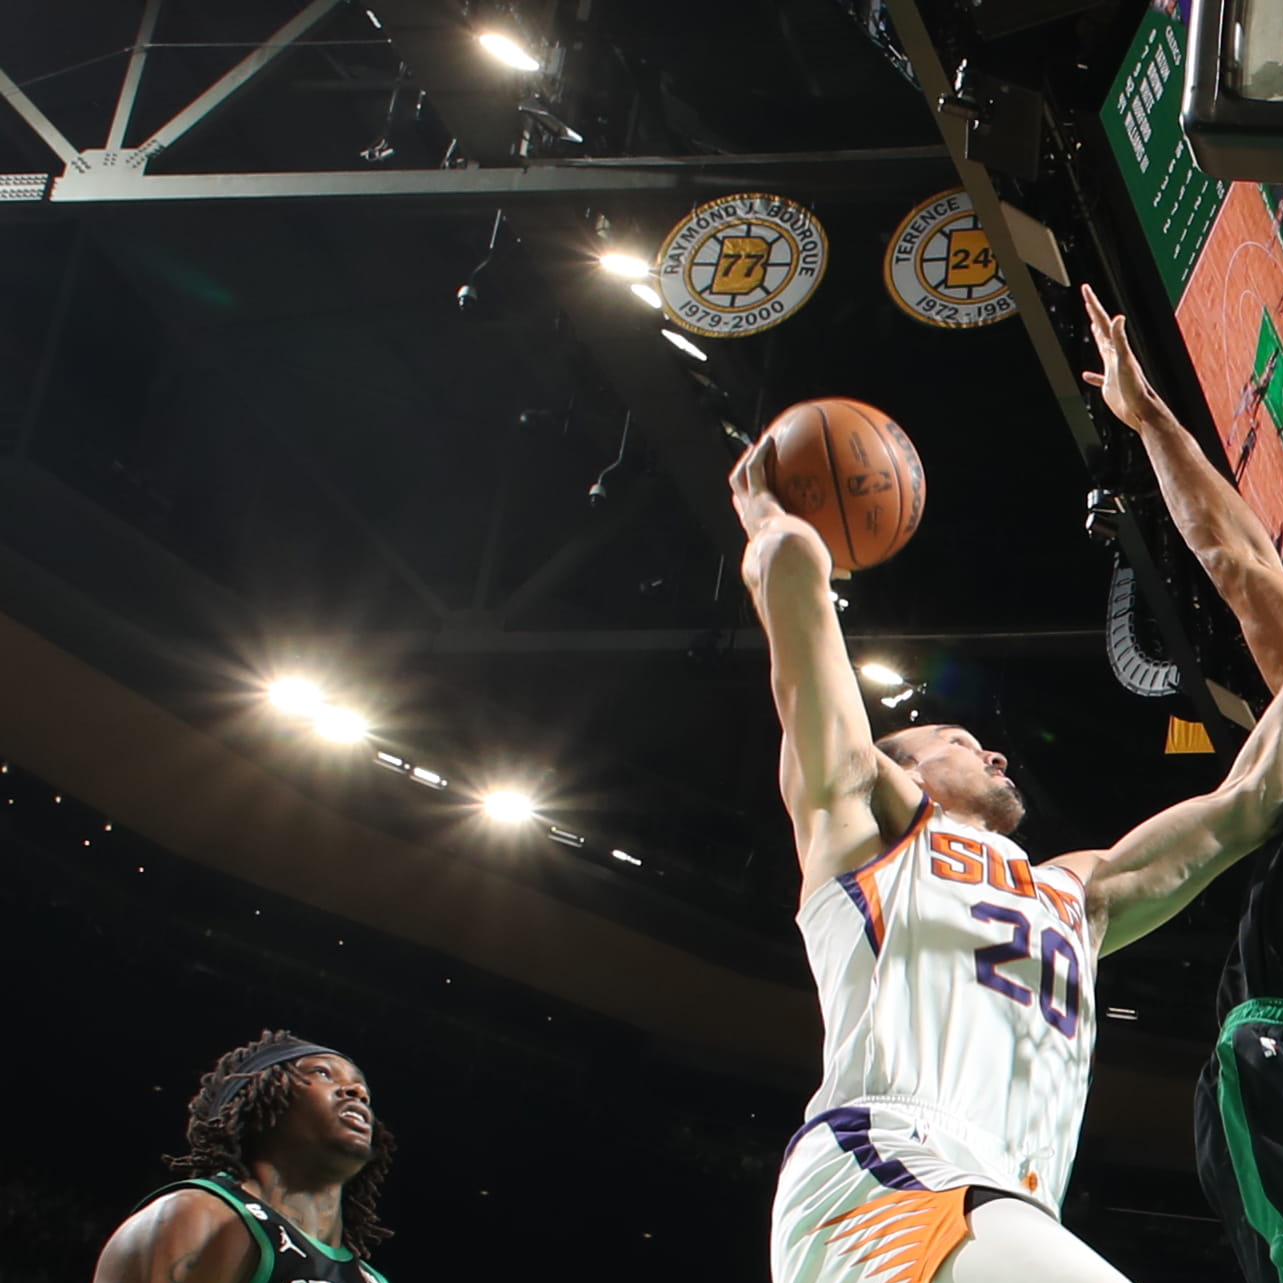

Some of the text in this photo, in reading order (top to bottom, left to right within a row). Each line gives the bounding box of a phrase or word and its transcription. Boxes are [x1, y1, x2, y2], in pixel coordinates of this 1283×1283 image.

[661, 204, 739, 276] RAYMOND
[765, 205, 816, 279] BOURQUE
[895, 198, 961, 266] TERENCE
[720, 252, 765, 279] 77
[951, 248, 994, 271] 24
[679, 299, 786, 330] 1979-2000
[970, 901, 1079, 1040] 20
